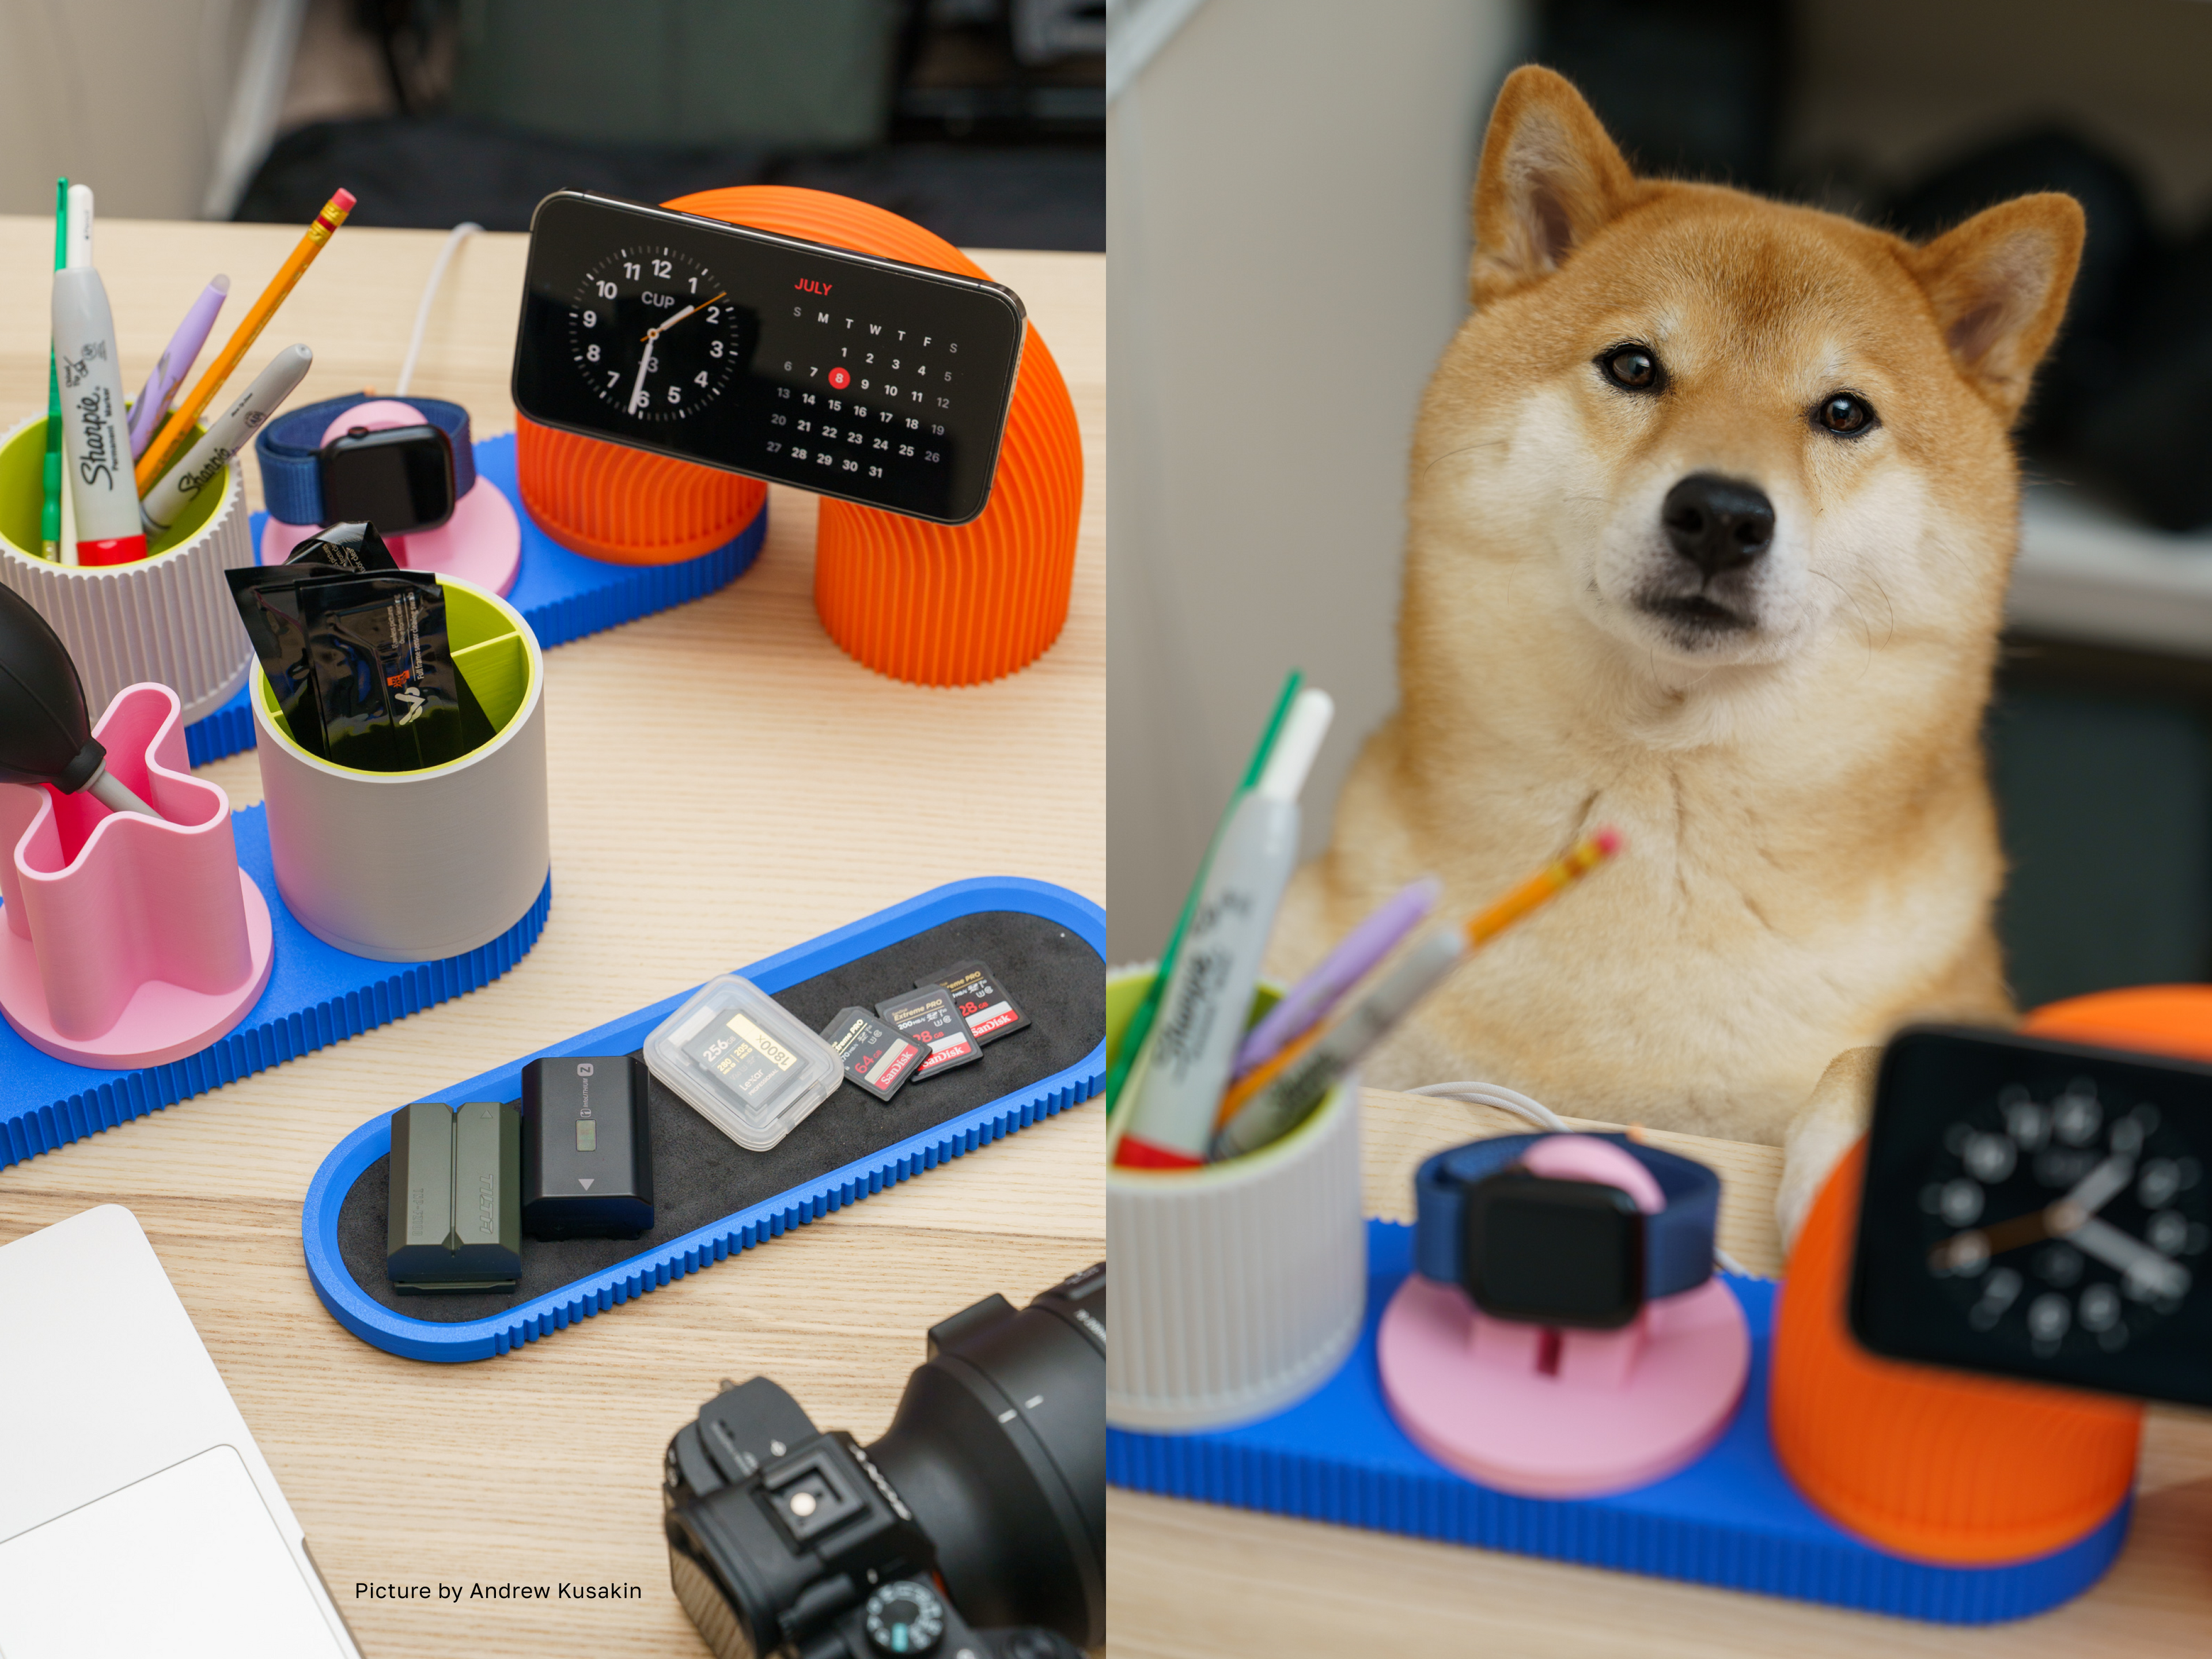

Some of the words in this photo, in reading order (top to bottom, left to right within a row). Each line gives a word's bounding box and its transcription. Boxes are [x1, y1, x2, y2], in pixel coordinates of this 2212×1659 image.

[623, 262, 641, 281] 11
[652, 259, 672, 279] 12
[596, 280, 618, 300] 10
[688, 277, 698, 294] 1
[794, 278, 833, 297] JULY
[641, 291, 675, 309] CUP
[582, 310, 597, 328] 9
[706, 306, 720, 324] 2
[794, 306, 802, 317] S
[818, 312, 830, 324] M
[845, 318, 854, 329] T
[870, 324, 882, 336] W
[897, 330, 907, 342] T
[923, 336, 932, 347] F
[949, 343, 958, 354] S
[586, 344, 601, 362] 8
[710, 340, 724, 358] 3
[842, 347, 848, 358] 1
[866, 353, 874, 364] 2
[892, 358, 900, 370] 3
[918, 365, 926, 376] 4
[944, 371, 952, 382] 5
[607, 370, 620, 388] 7
[694, 370, 709, 388] 4
[783, 361, 793, 372] 6
[810, 366, 819, 377] 7
[835, 373, 843, 384] 8
[860, 378, 870, 390] 9
[884, 384, 899, 397] 10
[911, 391, 923, 403] 11
[937, 397, 950, 409] 12
[103, 388, 112, 417] Marker
[635, 391, 650, 408] 6
[667, 385, 681, 404] 5
[777, 387, 791, 399] 13
[802, 392, 816, 406] 14
[827, 399, 842, 412] 15
[853, 405, 868, 418] 16
[879, 411, 893, 423] 17
[905, 417, 919, 430] 18
[931, 424, 945, 435] 19
[76, 391, 113, 491] Sharpie
[108, 425, 119, 471] Permanent
[771, 413, 787, 426] 20
[796, 419, 812, 433] 21
[821, 425, 838, 439] 22
[846, 431, 863, 445] 23
[872, 437, 889, 451] 24
[898, 444, 915, 457] 25
[924, 450, 940, 463] 26
[766, 441, 782, 453] 27
[790, 446, 808, 460] 28
[816, 452, 833, 466] 29
[842, 459, 859, 473] 30
[868, 465, 883, 479] 31
[387, 605, 397, 627] pictures
[415, 652, 423, 669] frame
[965, 971, 982, 982] PRO
[893, 1005, 925, 1022] Extreme
[926, 998, 942, 1010] PRO
[959, 1001, 978, 1017] 28
[978, 1001, 989, 1009] GB
[849, 1018, 864, 1035] PRO
[934, 1031, 945, 1039] GB
[971, 1014, 1012, 1037] SanDisk
[717, 1058, 732, 1072] 280
[733, 1042, 749, 1056] 205
[854, 1055, 874, 1074] 64
[873, 1049, 882, 1059] GB
[881, 1051, 914, 1085] SanDisk
[739, 1069, 764, 1091] Lexar
[748, 1069, 779, 1096] PROFESSIONAL
[479, 1174, 494, 1234] TILTA
